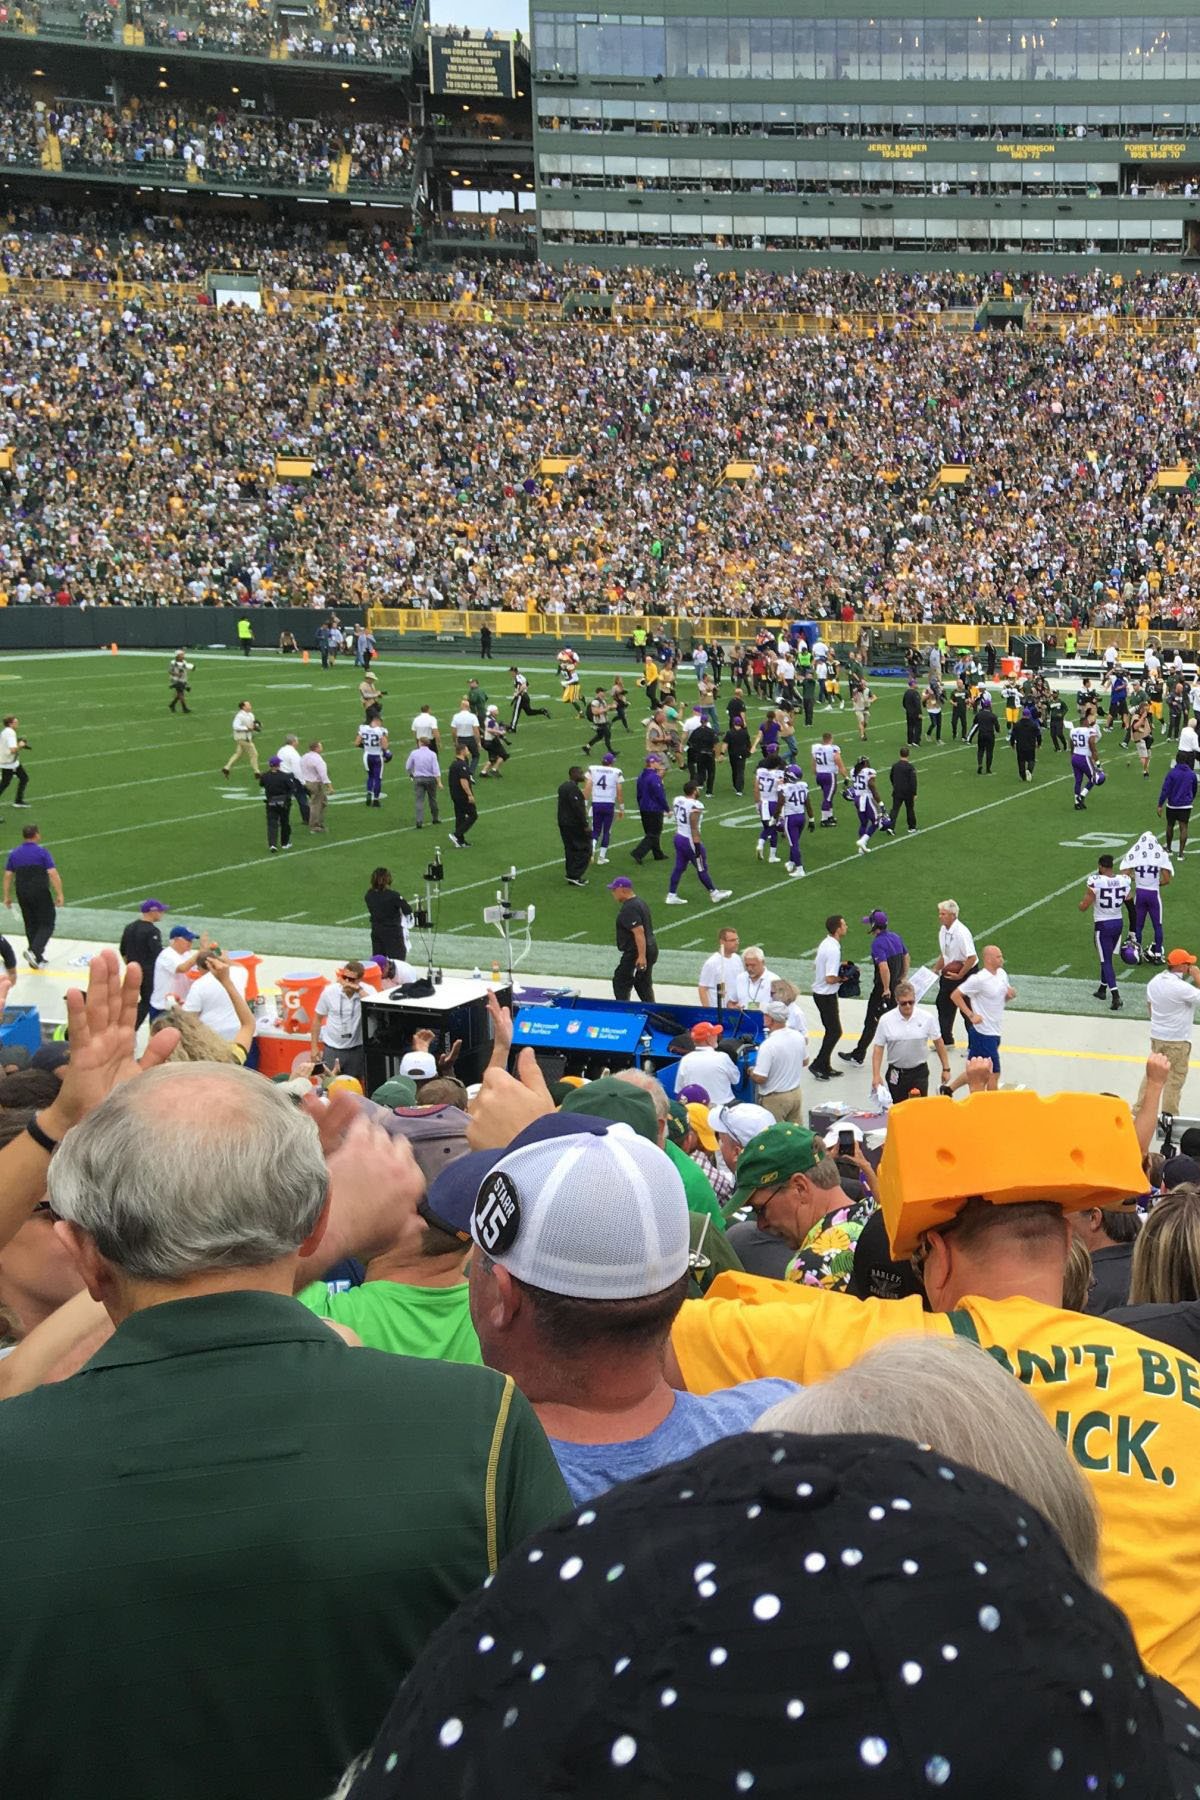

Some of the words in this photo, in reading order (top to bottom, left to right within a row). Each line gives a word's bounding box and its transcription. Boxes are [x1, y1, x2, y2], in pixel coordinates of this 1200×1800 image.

[868, 144, 892, 152] JERRY
[895, 144, 928, 152] KRAMER
[996, 144, 1014, 152] DAVE
[1017, 144, 1054, 152] ROBINSON
[1124, 144, 1158, 152] FORREST
[362, 734, 380, 747] 22
[597, 775, 607, 790] 4
[788, 790, 806, 806] 40
[1134, 866, 1159, 878] 44
[1100, 887, 1126, 908] 55
[284, 992, 300, 1009] G
[530, 1028, 552, 1036] Surface
[532, 1022, 560, 1031] Microsoft
[600, 1026, 628, 1036] Microsoft
[494, 1178, 517, 1219] STARR
[476, 1192, 508, 1249] 15
